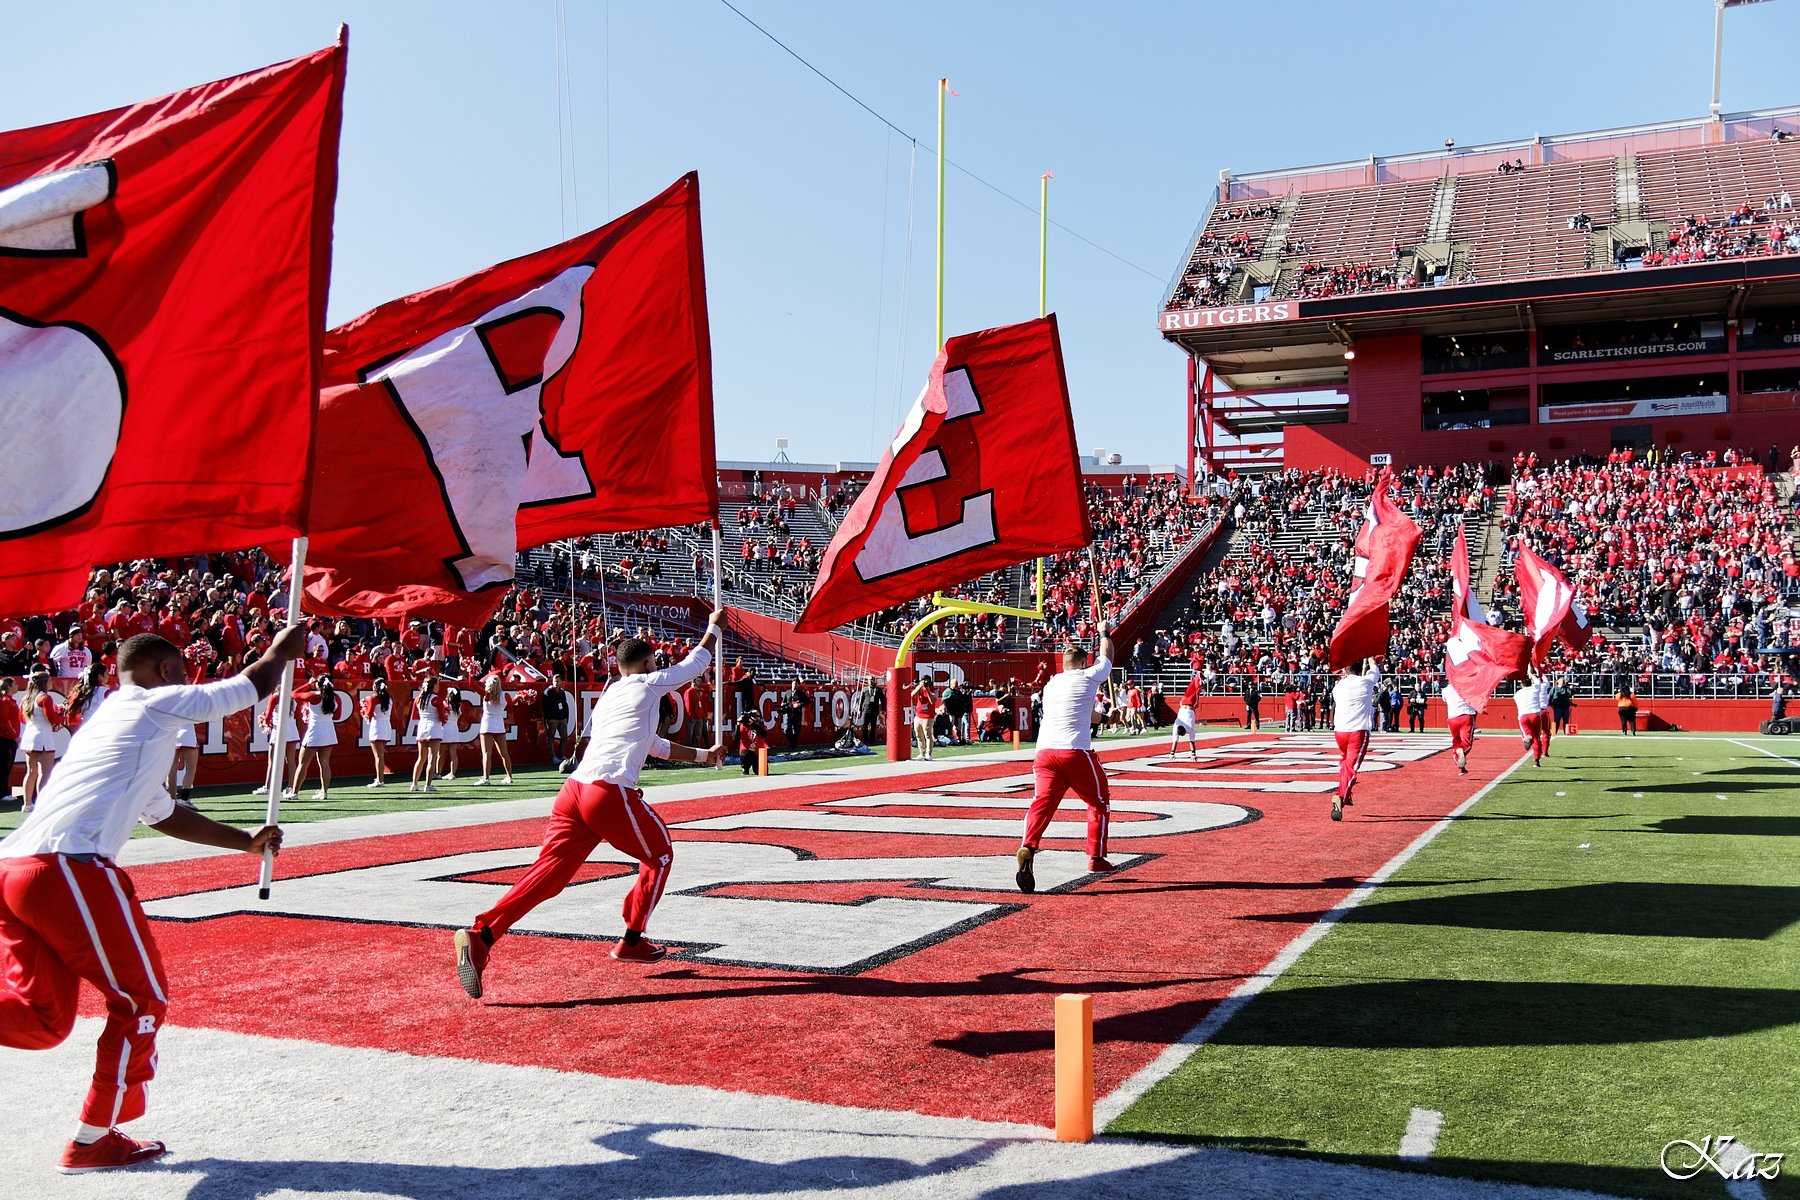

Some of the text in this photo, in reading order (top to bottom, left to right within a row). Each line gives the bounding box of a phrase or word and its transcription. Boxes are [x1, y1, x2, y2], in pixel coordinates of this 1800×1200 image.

[1165, 303, 1289, 330] RUTGERS
[1553, 341, 1707, 361] SCARLETKNIGHTS.COM
[356, 262, 597, 593] R
[1373, 455, 1388, 463] 101
[852, 363, 999, 584] E
[69, 656, 85, 668] 27
[108, 663, 116, 675] R
[296, 658, 305, 669] R
[363, 662, 371, 674] R
[1018, 707, 1029, 731] R
[1568, 725, 1577, 735] G
[138, 1015, 156, 1035] R
